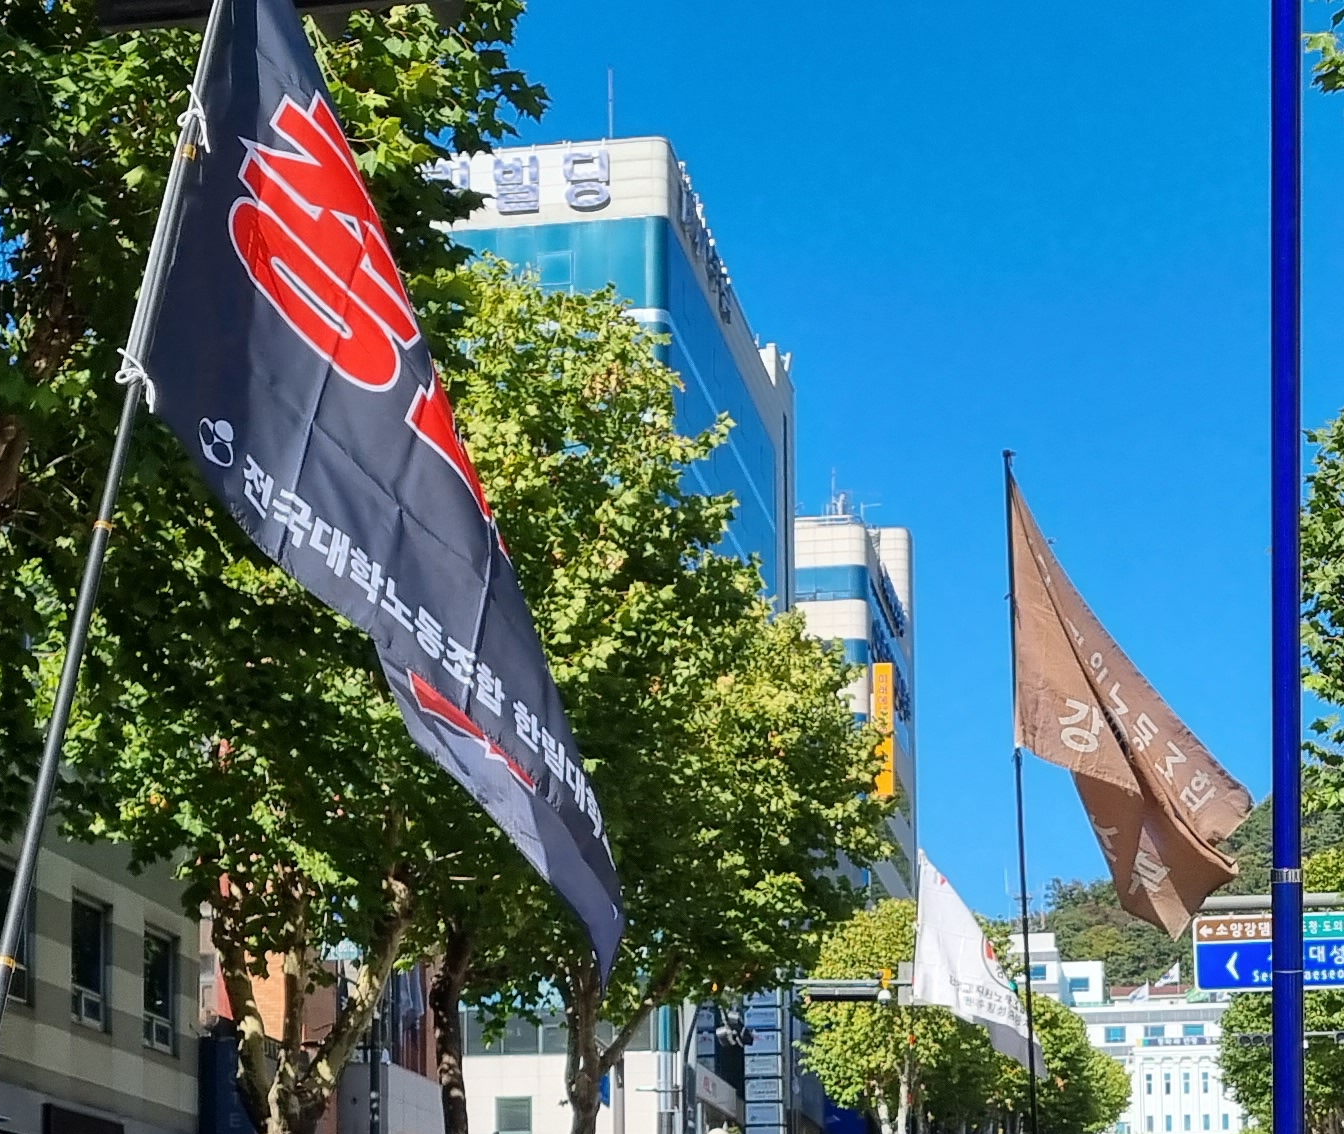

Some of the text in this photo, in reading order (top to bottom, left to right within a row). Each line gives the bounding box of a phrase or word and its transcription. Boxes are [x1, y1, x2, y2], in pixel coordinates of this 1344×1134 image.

[241, 454, 606, 840] 전국대학노동조합 한림대학
[1215, 921, 1272, 938] 소양강댐
